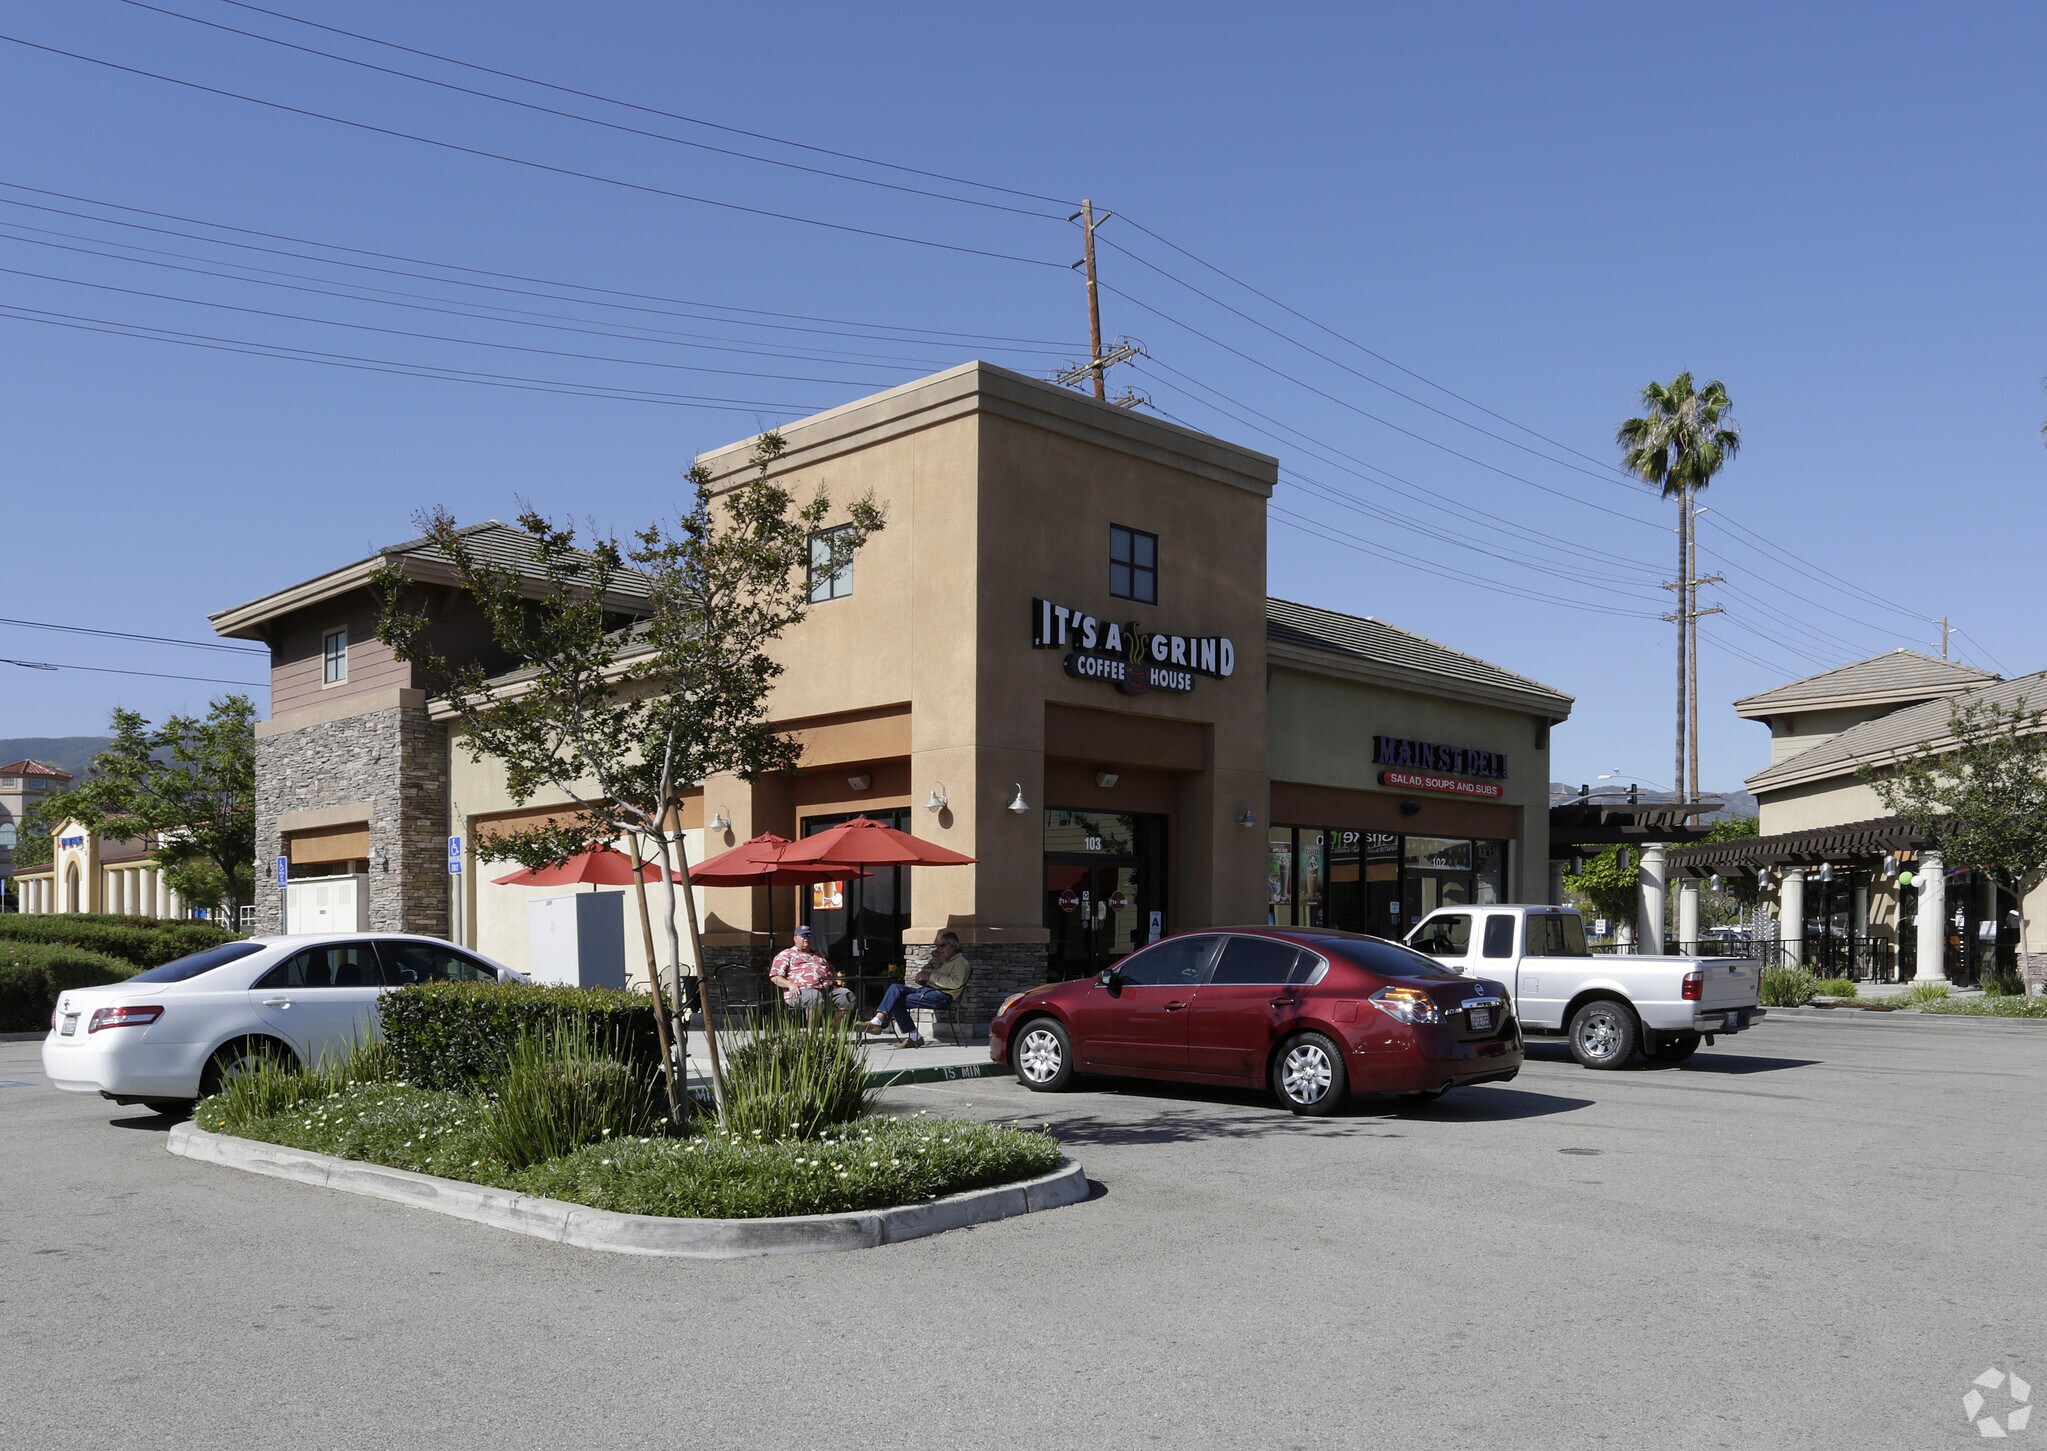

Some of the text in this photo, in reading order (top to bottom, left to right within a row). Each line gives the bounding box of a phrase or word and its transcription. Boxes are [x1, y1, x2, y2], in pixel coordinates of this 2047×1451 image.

[1042, 600, 1235, 677] IT'S A GRIND
[1077, 655, 1191, 691] COFFEE HOUSE
[1378, 735, 1509, 779] MAIN ST DELI
[1390, 773, 1498, 795] SALAD, SOUPS AND SUBS
[1085, 837, 1101, 850] 103
[1432, 858, 1446, 867] 102
[1152, 917, 1159, 927] A
[942, 1064, 981, 1080] 15 MIN
